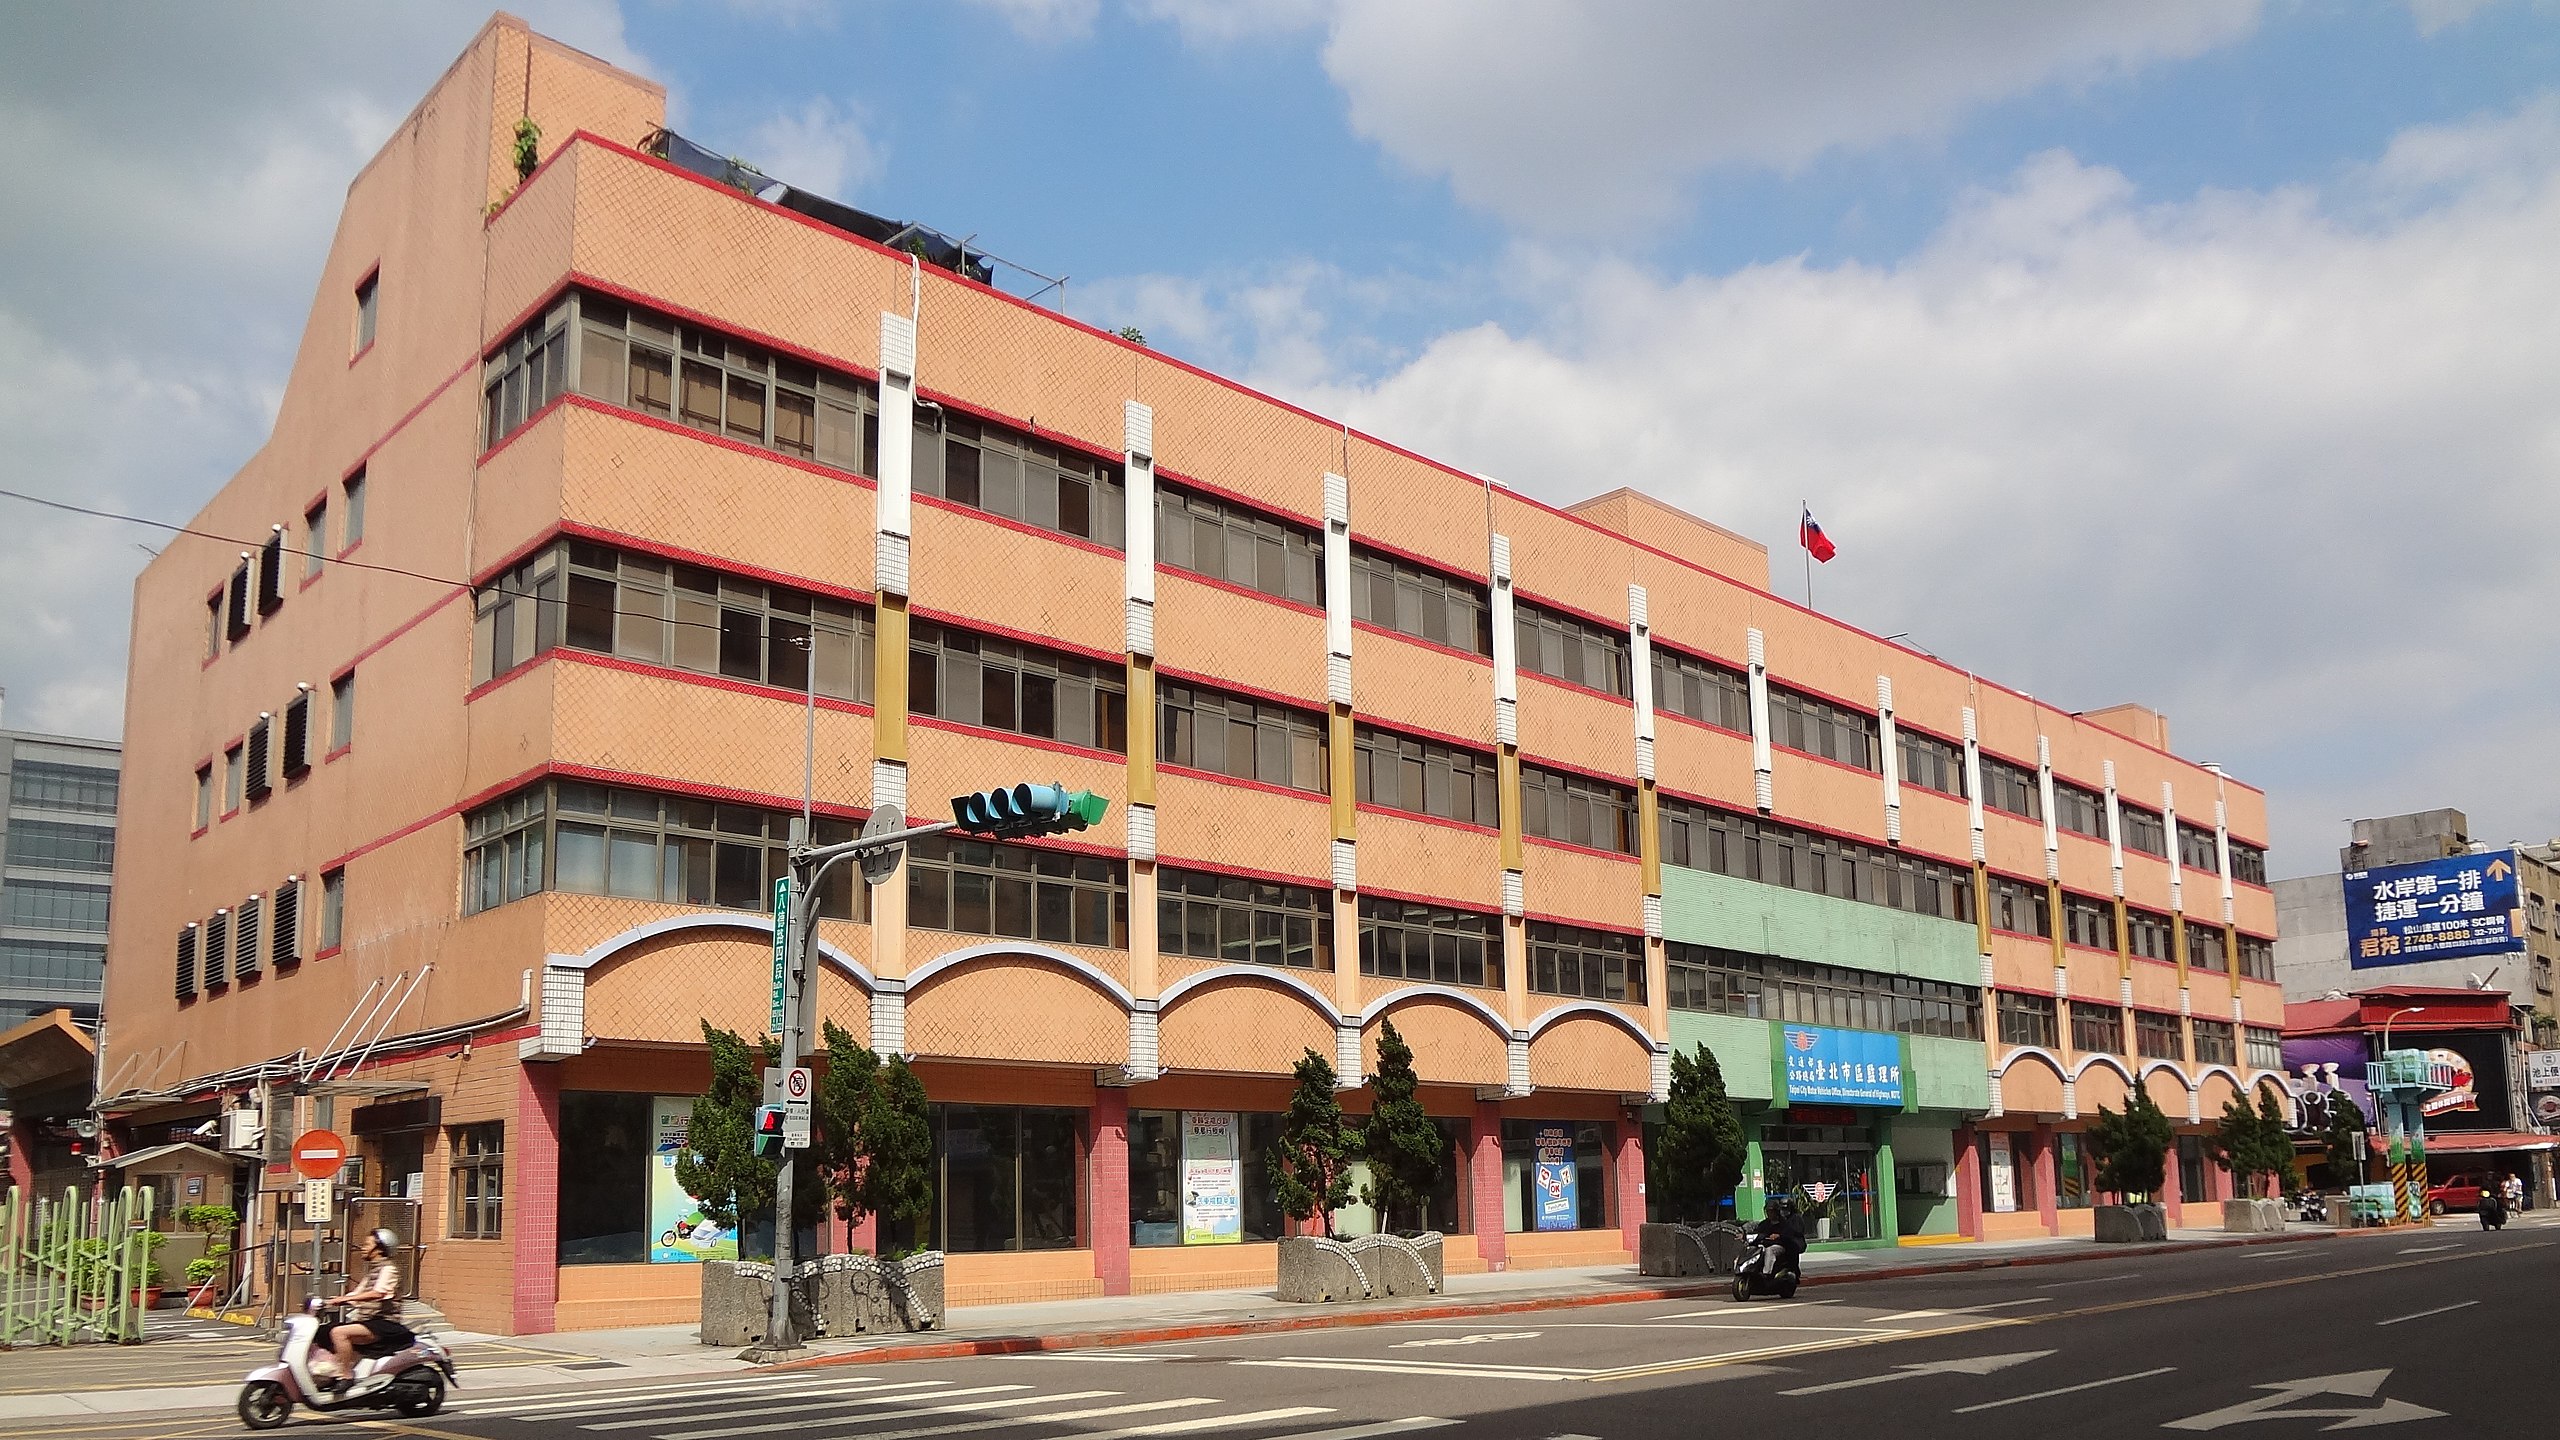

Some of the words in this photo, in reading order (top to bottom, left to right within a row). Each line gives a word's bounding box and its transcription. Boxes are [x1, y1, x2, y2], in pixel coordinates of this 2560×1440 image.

[2372, 869, 2482, 901] 水岸第一排
[2374, 891, 2486, 922] 捷運一分鐘
[775, 893, 786, 979] 八德路四段
[2404, 930, 2471, 945] 2748-8888
[2359, 934, 2401, 958] 君苑
[1788, 1055, 1814, 1069] 交通部
[1815, 1059, 1900, 1086] 臺北市區監理所
[2532, 1066, 2560, 1078] 池上便
[1788, 1084, 1800, 1095] Taipei
[1800, 1085, 1808, 1097] City
[1550, 1185, 1560, 1193] OK
